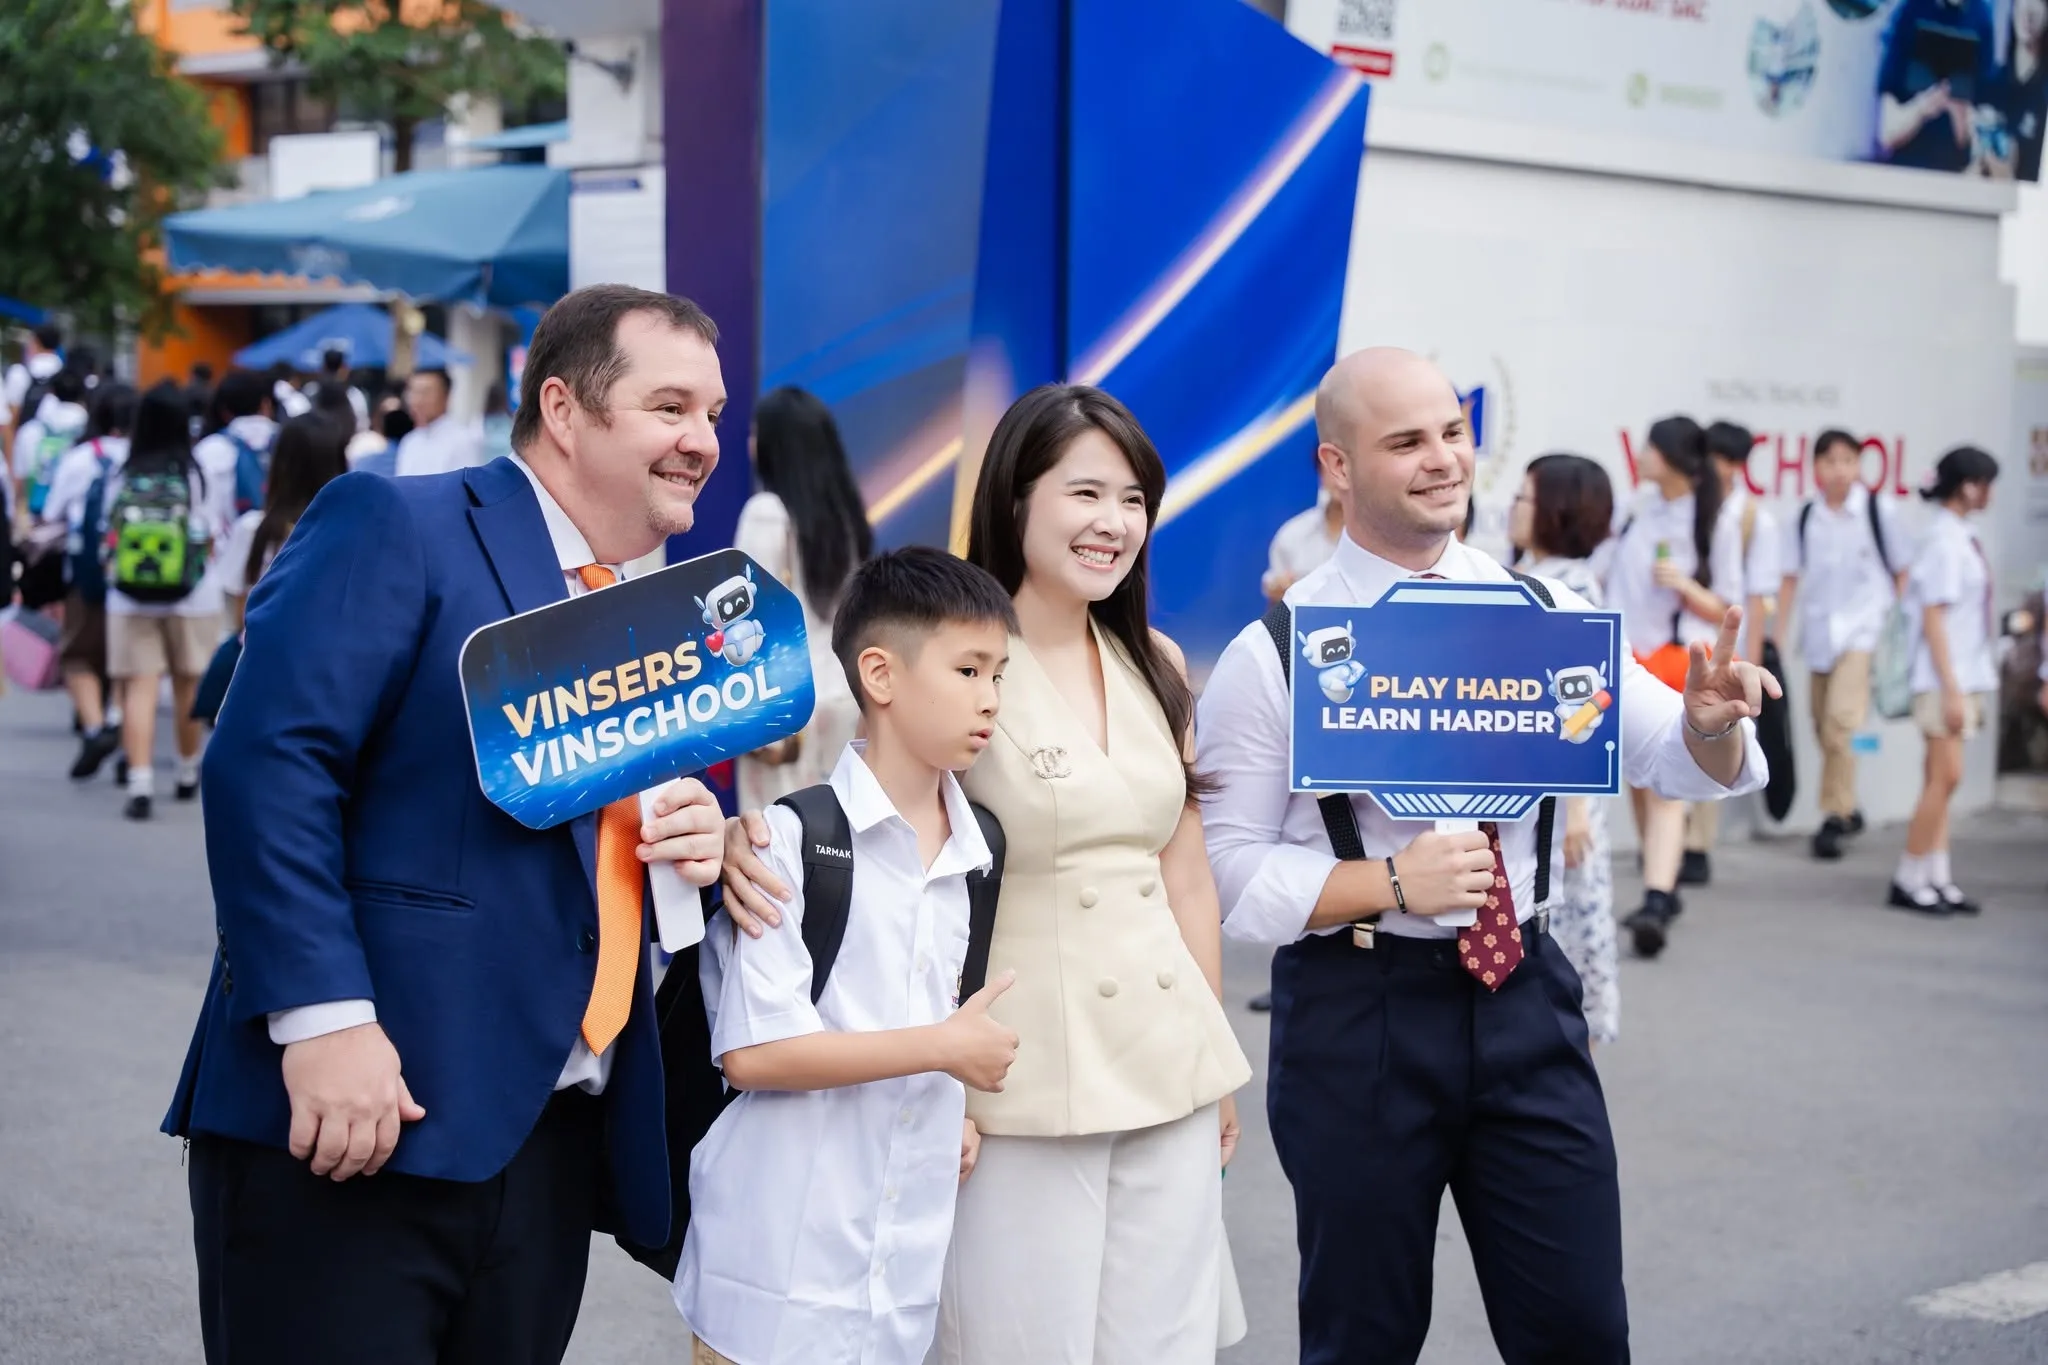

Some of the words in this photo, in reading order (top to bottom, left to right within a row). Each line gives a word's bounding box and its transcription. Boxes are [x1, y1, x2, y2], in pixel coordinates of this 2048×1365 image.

[502, 641, 702, 738] VINSERS
[1370, 676, 1449, 699] PLAY
[1456, 678, 1542, 701] HARD
[511, 665, 781, 786] VINSCHOOL
[1322, 707, 1421, 731] LEARN
[1430, 709, 1555, 733] HARDER
[815, 844, 852, 859] TARMAK
